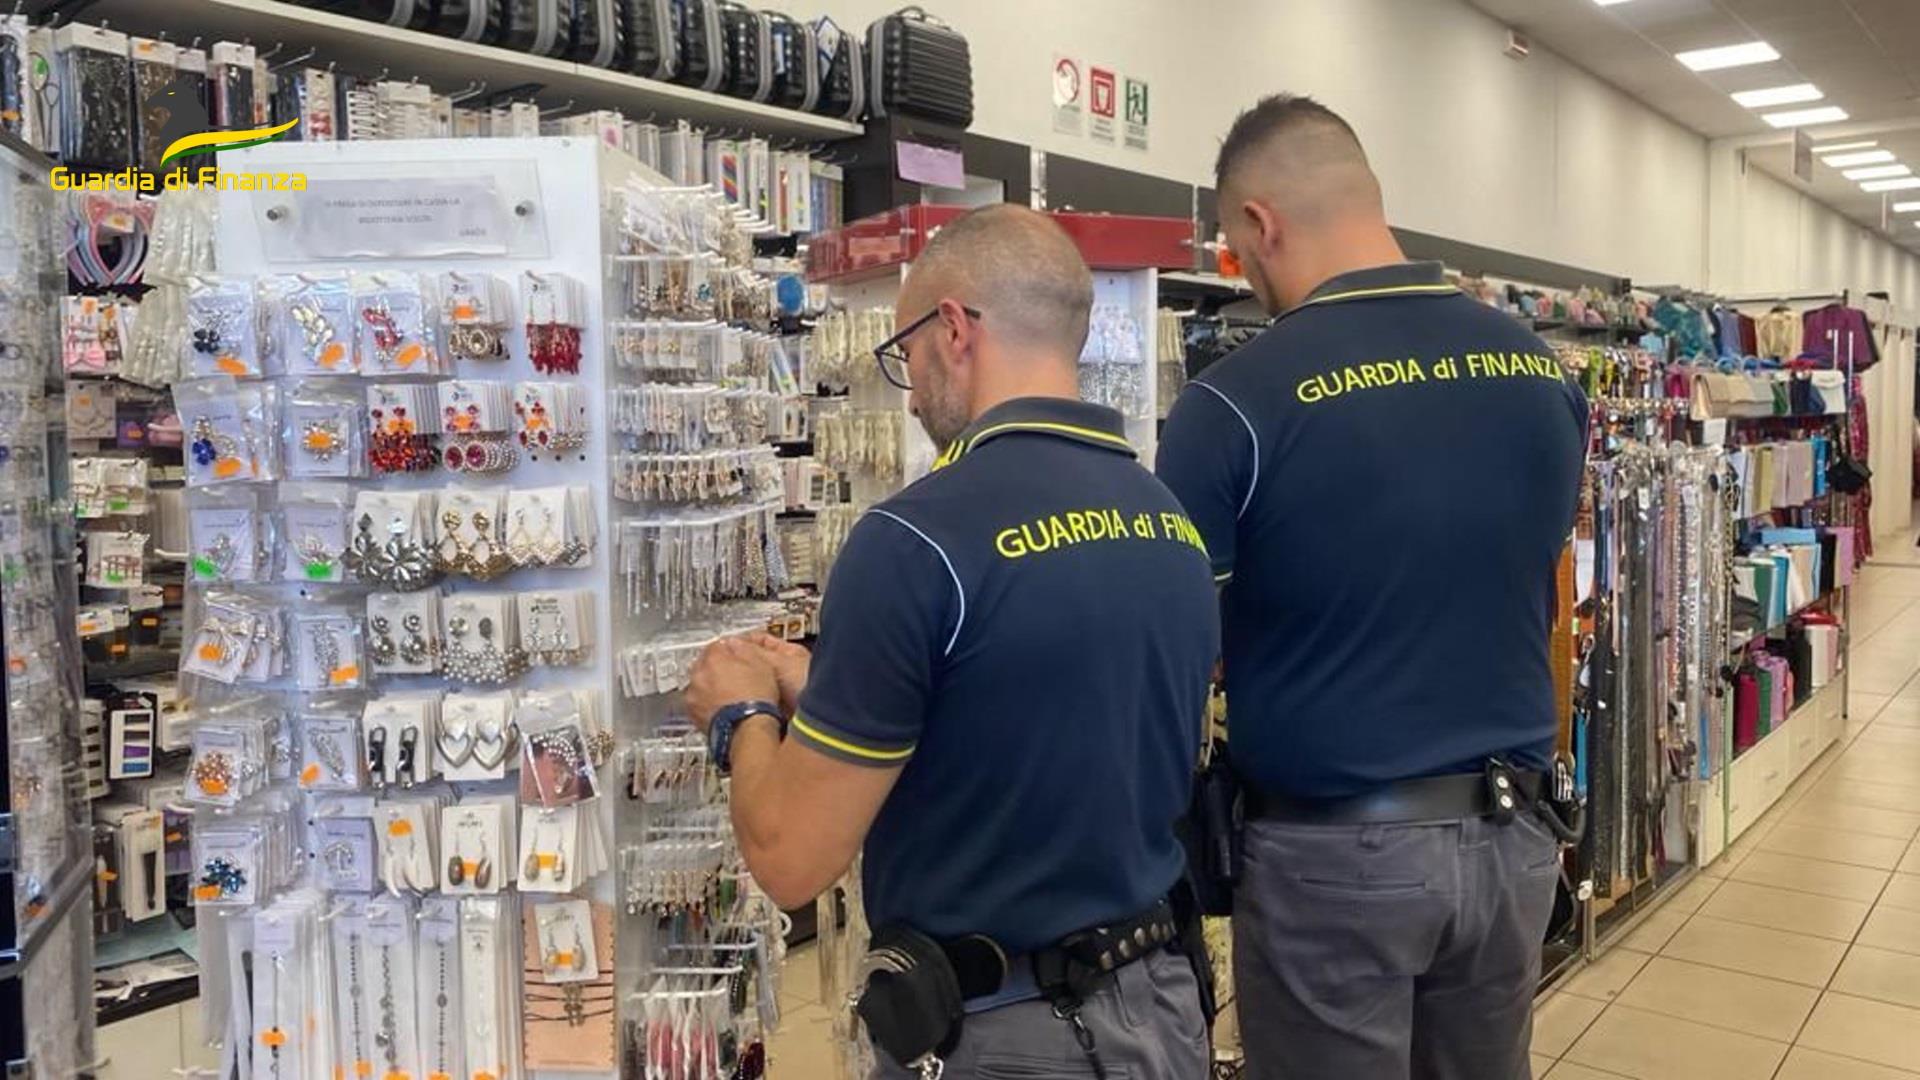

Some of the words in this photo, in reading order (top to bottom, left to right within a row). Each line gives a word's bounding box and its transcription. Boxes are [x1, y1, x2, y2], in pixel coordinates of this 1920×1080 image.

[1296, 358, 1427, 403] GUARDIA
[1432, 357, 1458, 379] di
[996, 509, 1130, 558] GUARDIA
[1133, 513, 1156, 539] di
